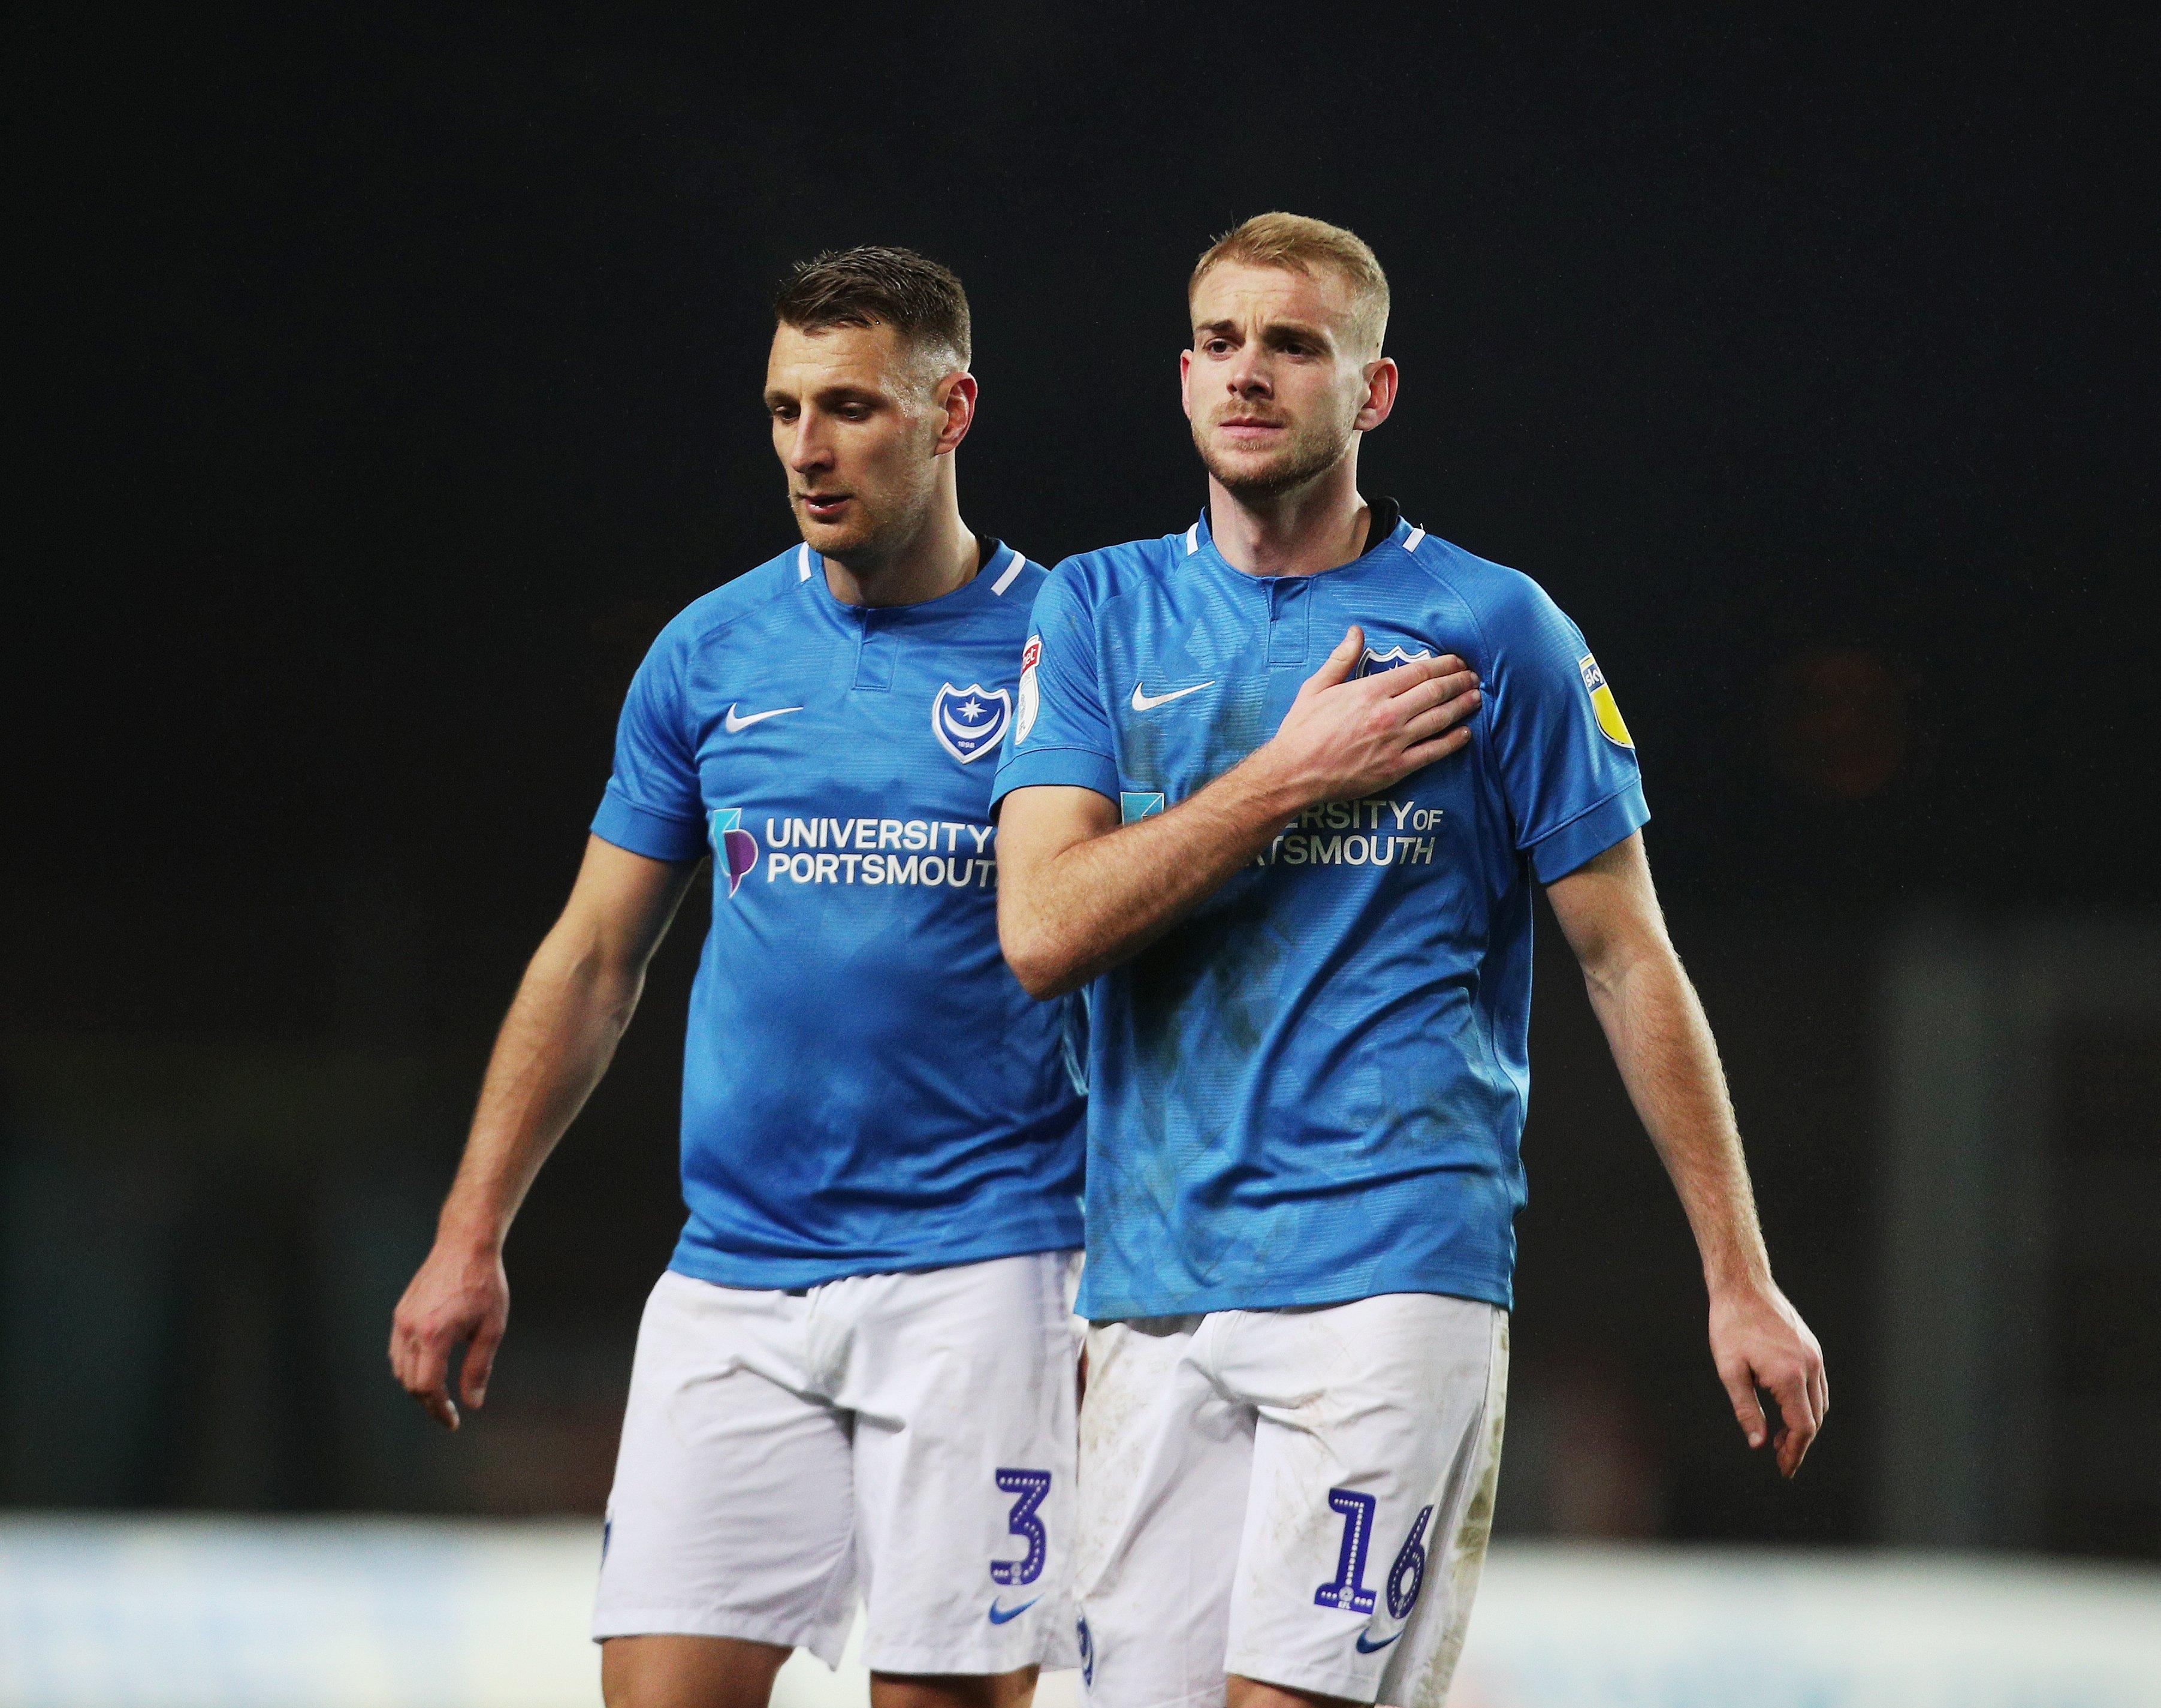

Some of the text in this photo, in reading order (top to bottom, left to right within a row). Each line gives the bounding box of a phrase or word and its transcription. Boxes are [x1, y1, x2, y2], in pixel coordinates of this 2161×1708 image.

[1285, 801, 1443, 831] RSITY OF
[766, 817, 994, 854] UNIVERSITY
[1256, 834, 1436, 867] TSMOUTH
[767, 853, 999, 888] PORTSMOUT
[991, 1467, 1052, 1586] 3
[1314, 1487, 1435, 1619] 16
